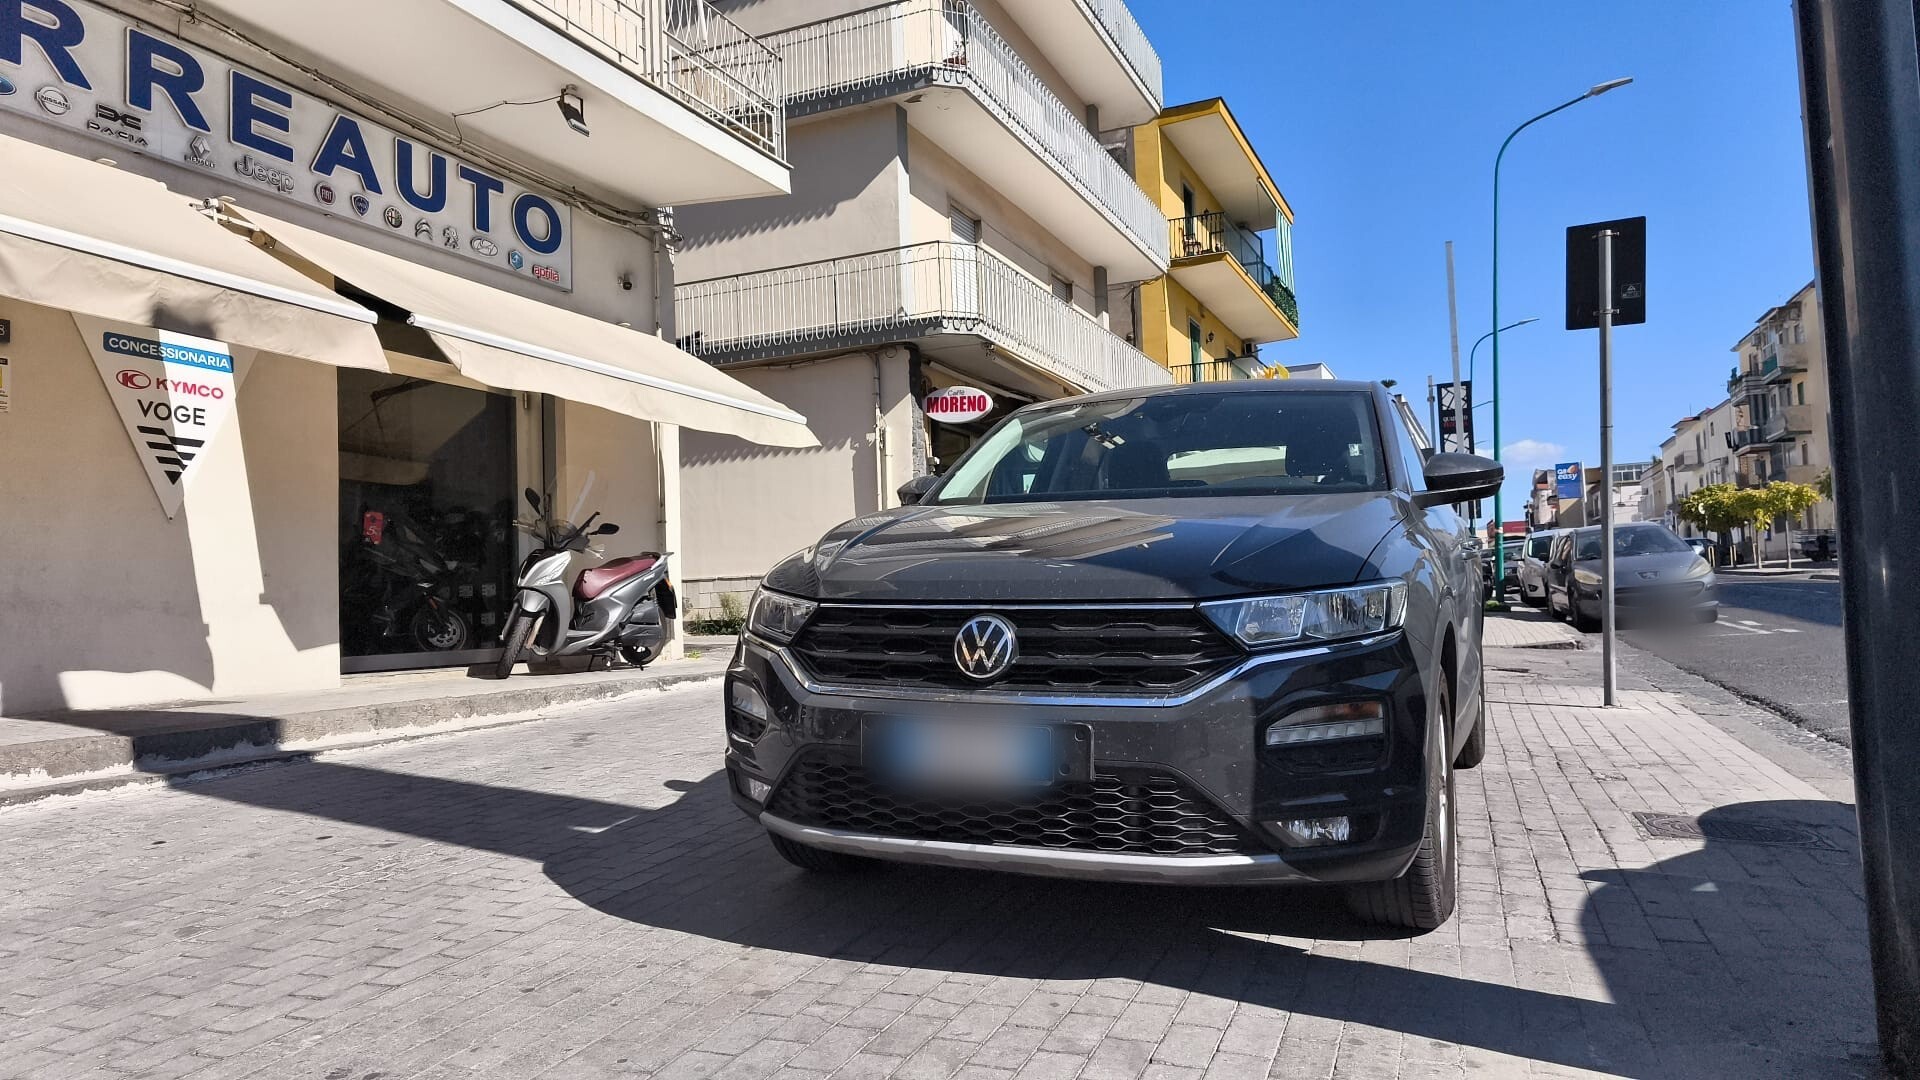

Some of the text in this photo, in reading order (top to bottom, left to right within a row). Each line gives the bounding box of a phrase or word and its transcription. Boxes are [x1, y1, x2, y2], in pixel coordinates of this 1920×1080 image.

[87, 120, 149, 146] DACIA
[235, 155, 295, 192] Jeep
[533, 265, 560, 282] aprilia
[109, 337, 229, 369] CONCESSIONARIA
[156, 378, 224, 400] KYMCO
[137, 399, 206, 426] VOGE
[926, 395, 987, 413] MORENO
